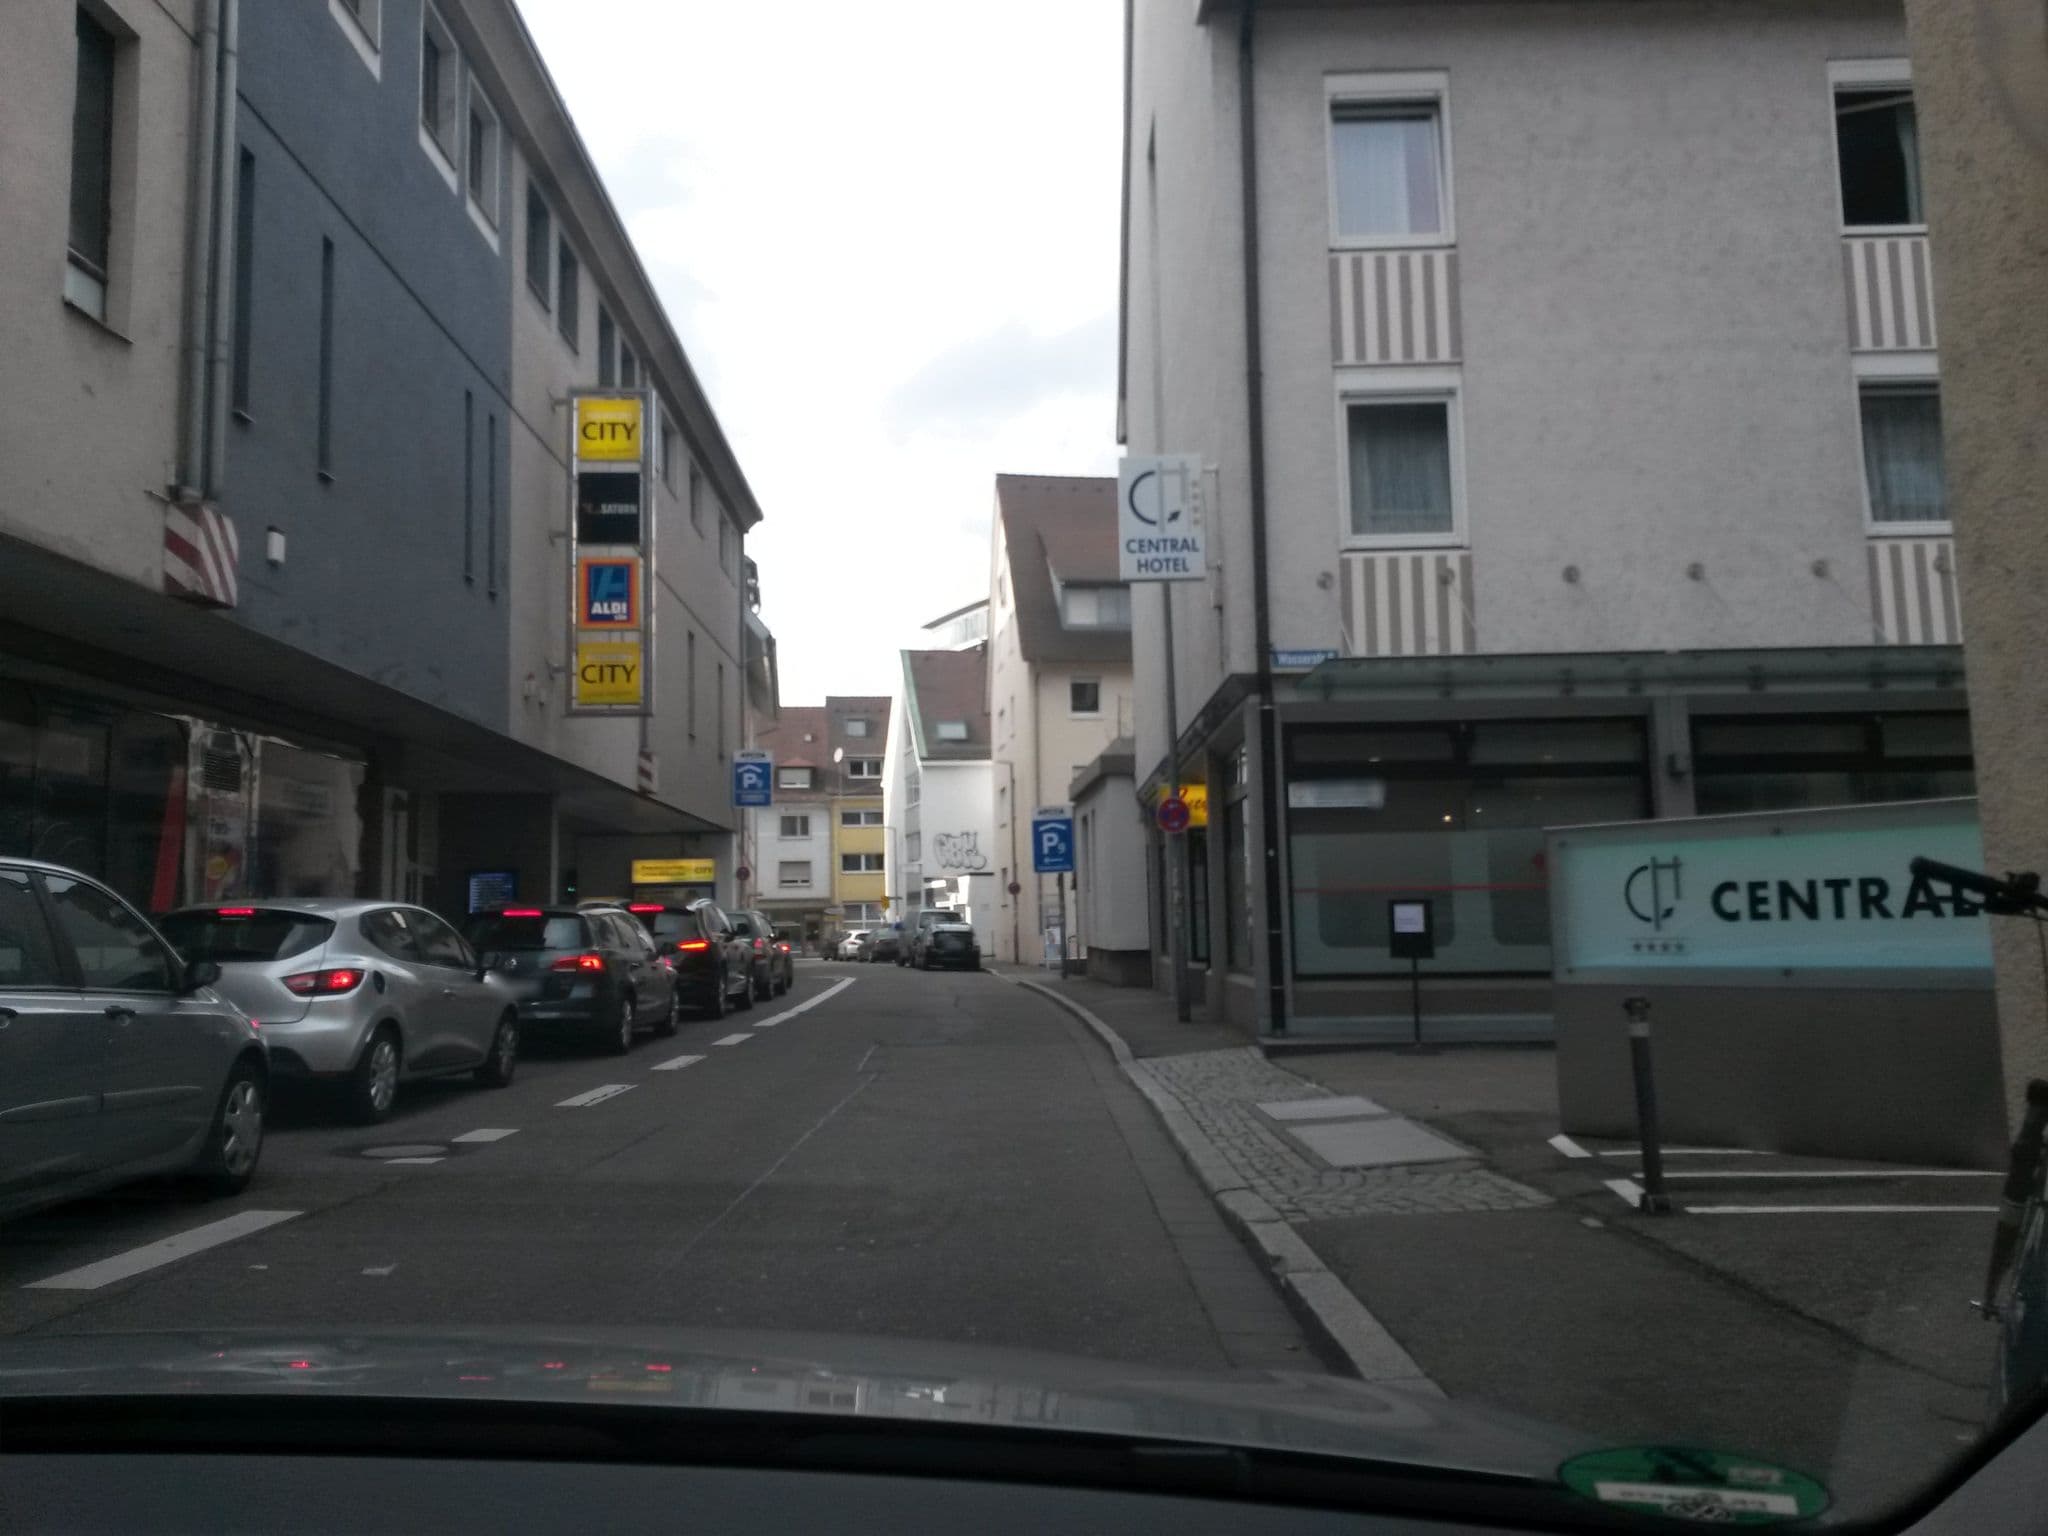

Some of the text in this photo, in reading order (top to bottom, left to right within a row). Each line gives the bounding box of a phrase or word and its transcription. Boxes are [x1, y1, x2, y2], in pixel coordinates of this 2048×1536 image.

[582, 421, 637, 441] CITY
[601, 503, 638, 515] SATURN
[1126, 538, 1200, 554] CENTRAL
[1136, 558, 1190, 574] HOTEL
[590, 601, 628, 615] ALDI
[581, 664, 637, 684] CITY
[1711, 875, 1980, 922] CENTRAL
